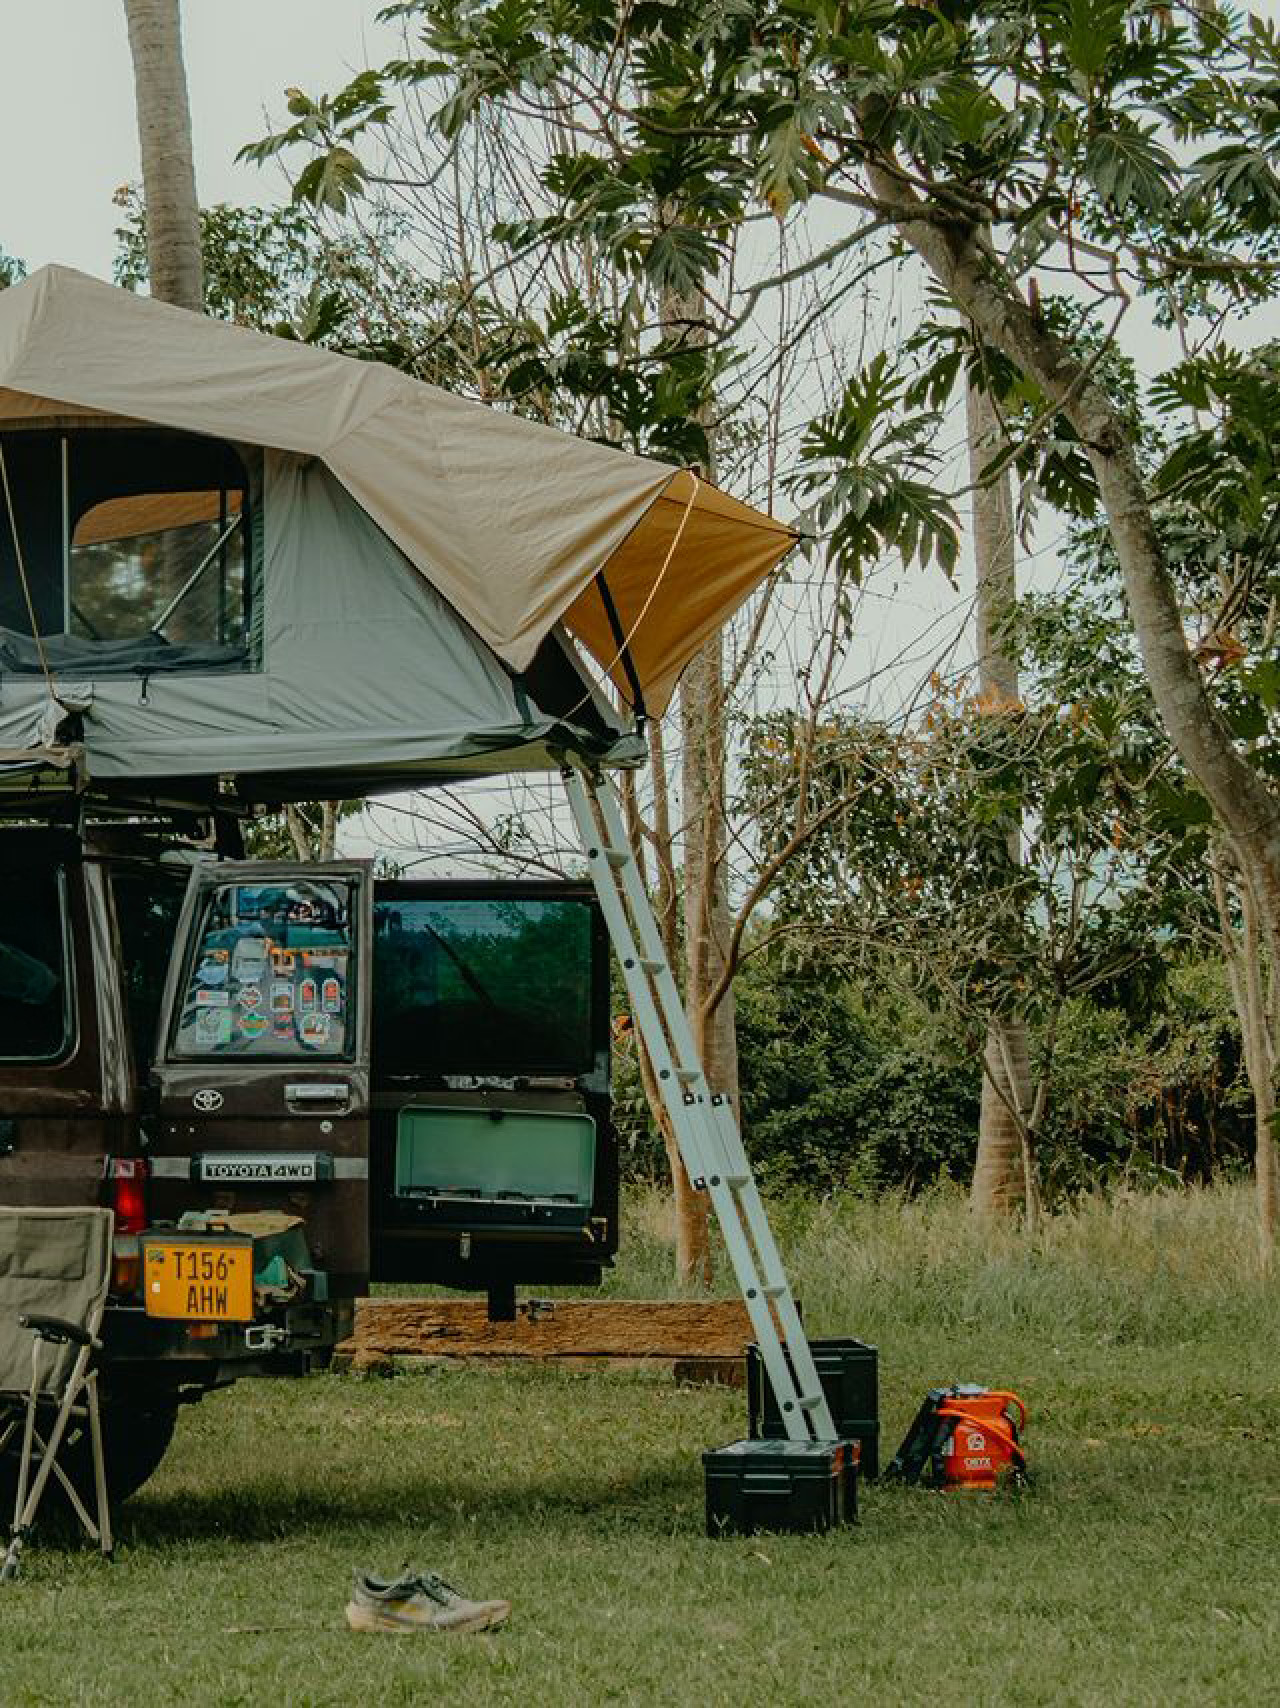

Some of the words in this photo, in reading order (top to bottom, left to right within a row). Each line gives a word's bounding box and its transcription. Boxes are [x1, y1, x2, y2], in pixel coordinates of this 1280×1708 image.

[205, 1163, 272, 1178] TOYOTA
[273, 1164, 313, 1178] 4WD
[172, 1251, 229, 1280] T156
[186, 1284, 229, 1313] AHW
